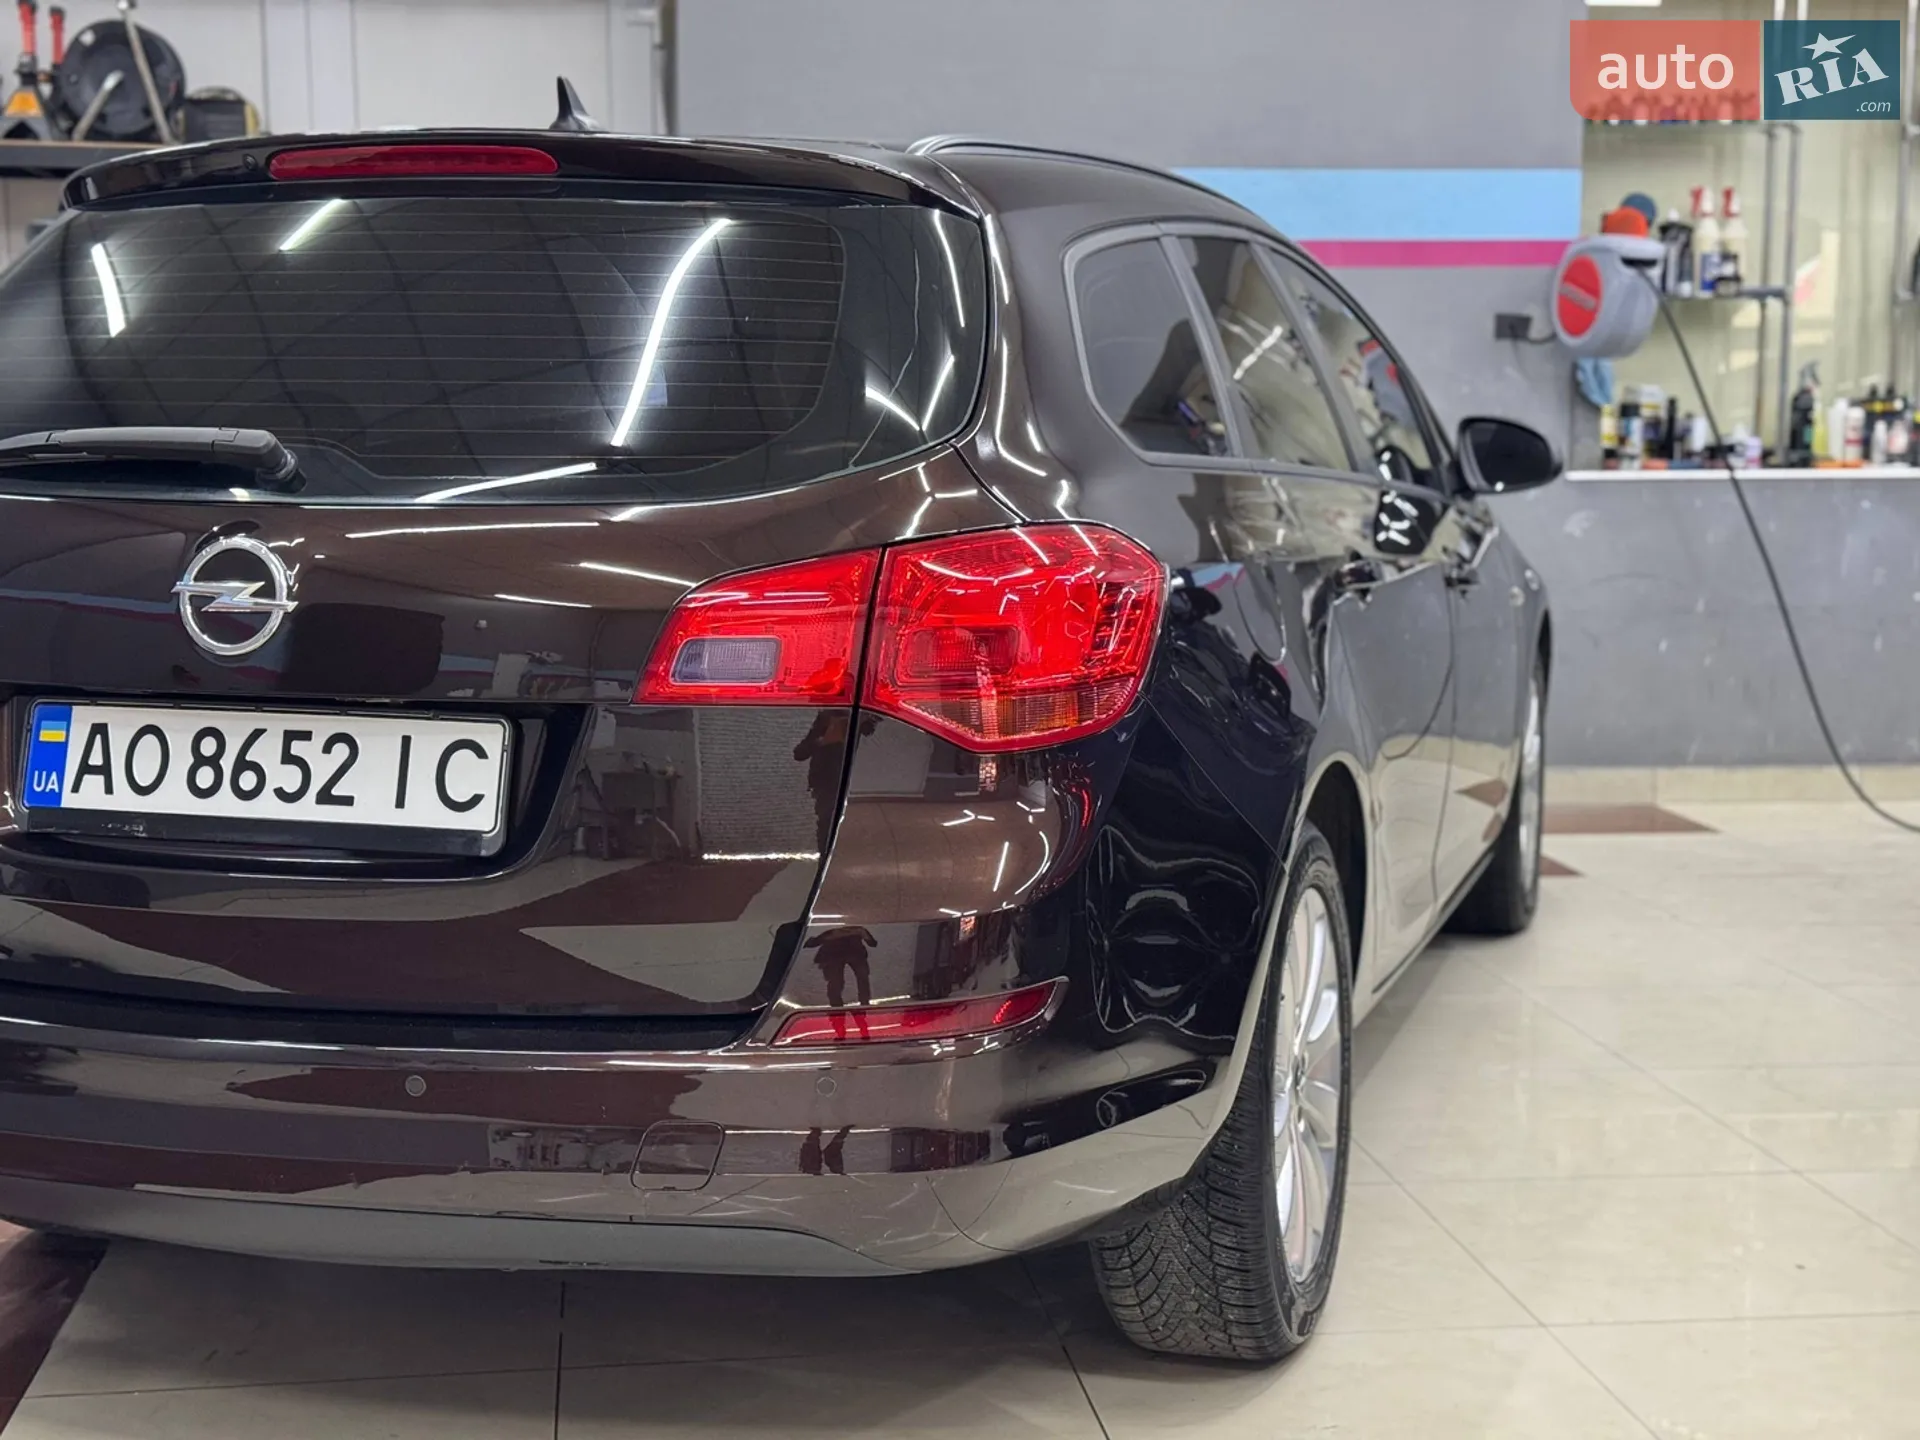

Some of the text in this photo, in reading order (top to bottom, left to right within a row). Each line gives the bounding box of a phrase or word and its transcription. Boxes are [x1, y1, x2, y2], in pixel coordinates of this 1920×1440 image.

[32, 770, 59, 793] UA
[71, 722, 489, 813] AO 8652 IC
